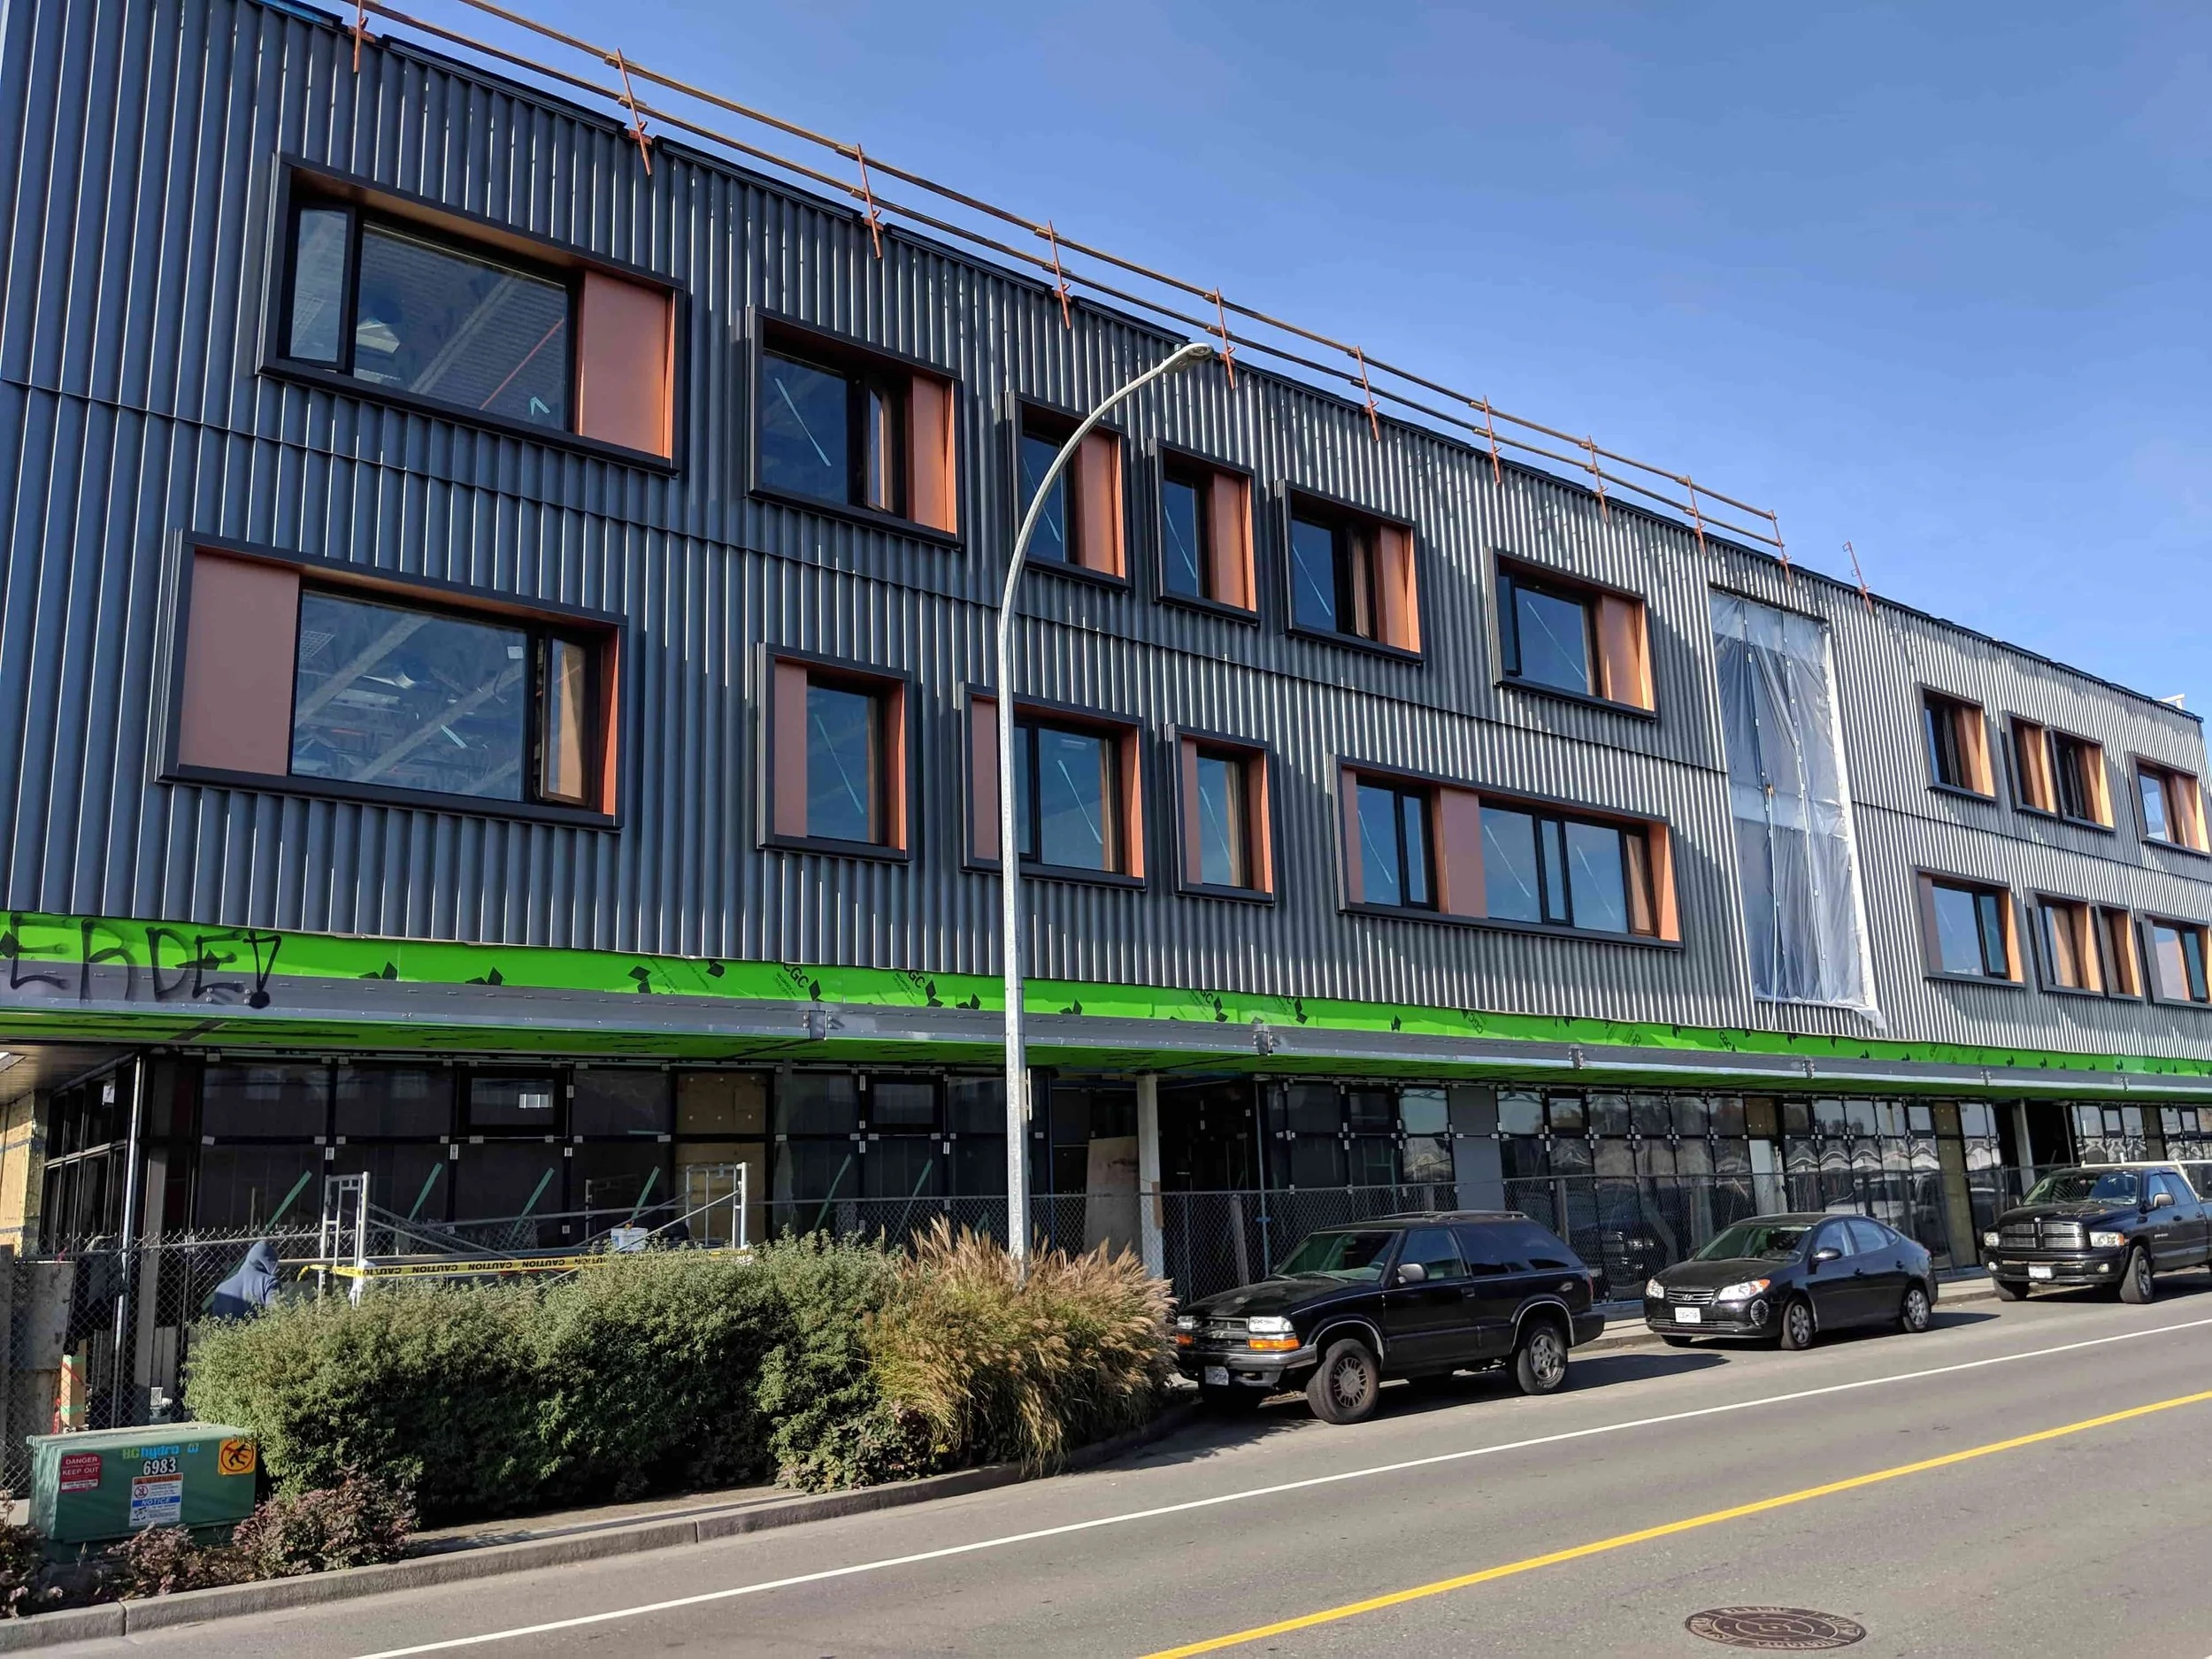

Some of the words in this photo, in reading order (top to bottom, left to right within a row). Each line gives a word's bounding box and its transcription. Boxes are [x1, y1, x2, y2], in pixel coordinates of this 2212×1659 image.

[468, 1262, 512, 1271] CAUTION
[522, 1259, 565, 1268] CAUTION
[412, 1264, 458, 1273] CAUTION
[65, 1456, 98, 1465] DANGER
[143, 1457, 176, 1475] 6983
[142, 1497, 171, 1506] NOTICE
